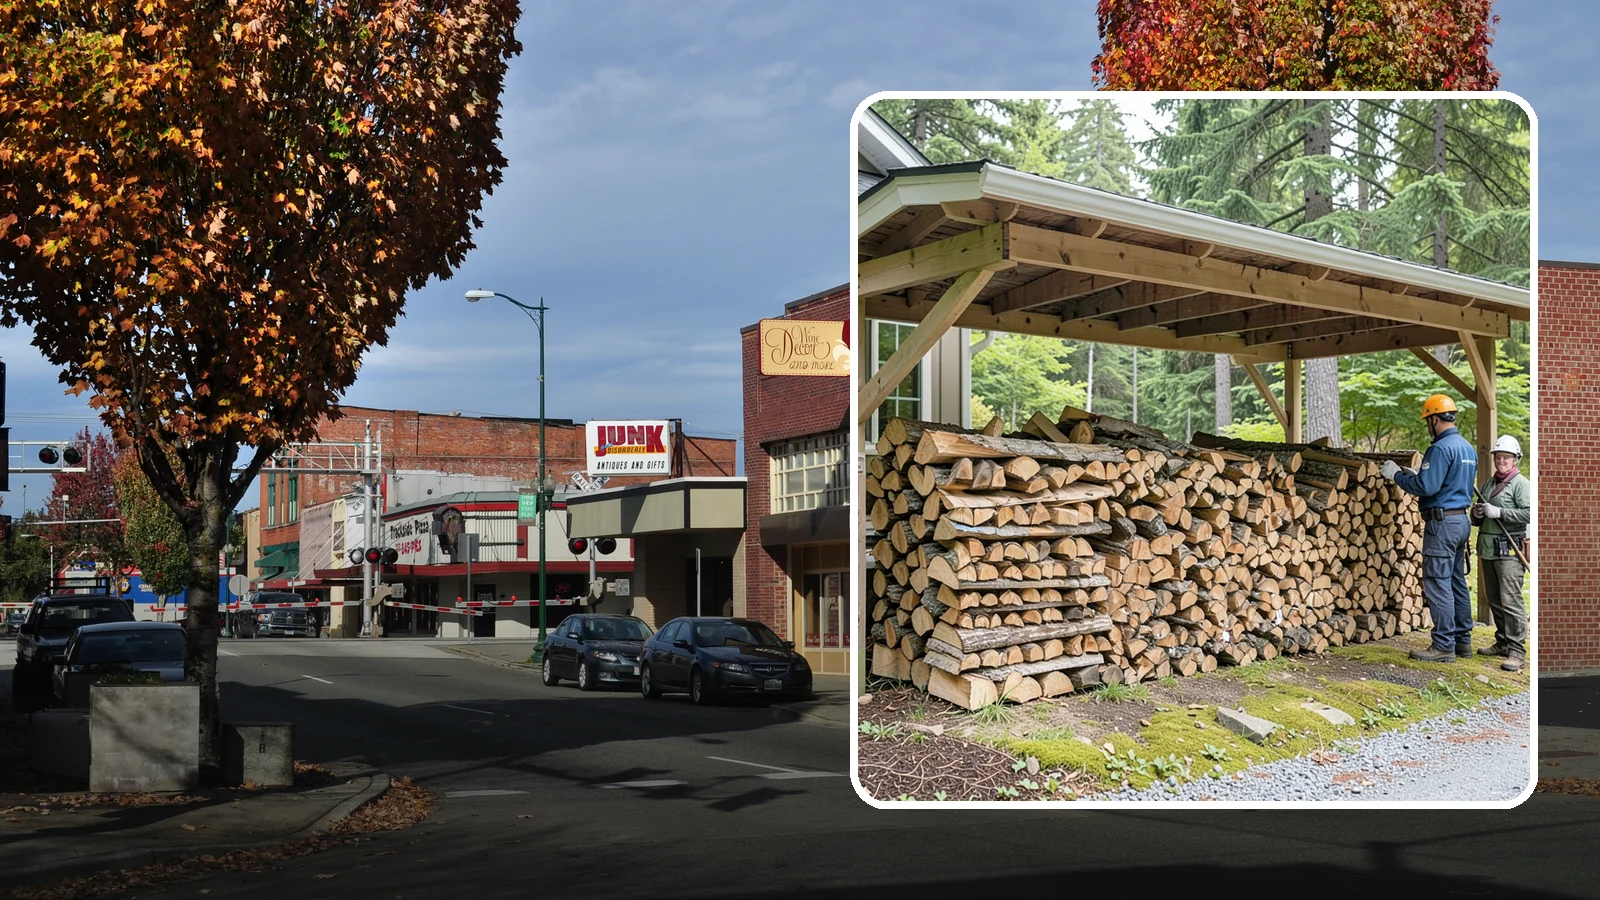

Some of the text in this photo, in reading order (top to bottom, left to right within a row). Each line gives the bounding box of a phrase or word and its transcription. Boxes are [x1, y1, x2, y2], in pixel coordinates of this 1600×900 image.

[765, 328, 830, 365] Decor
[596, 425, 665, 457] JUNK
[607, 446, 646, 454] DISORDERLY
[597, 460, 665, 470] ANTIQUES AND GIFTS
[414, 519, 429, 535] Pizza
